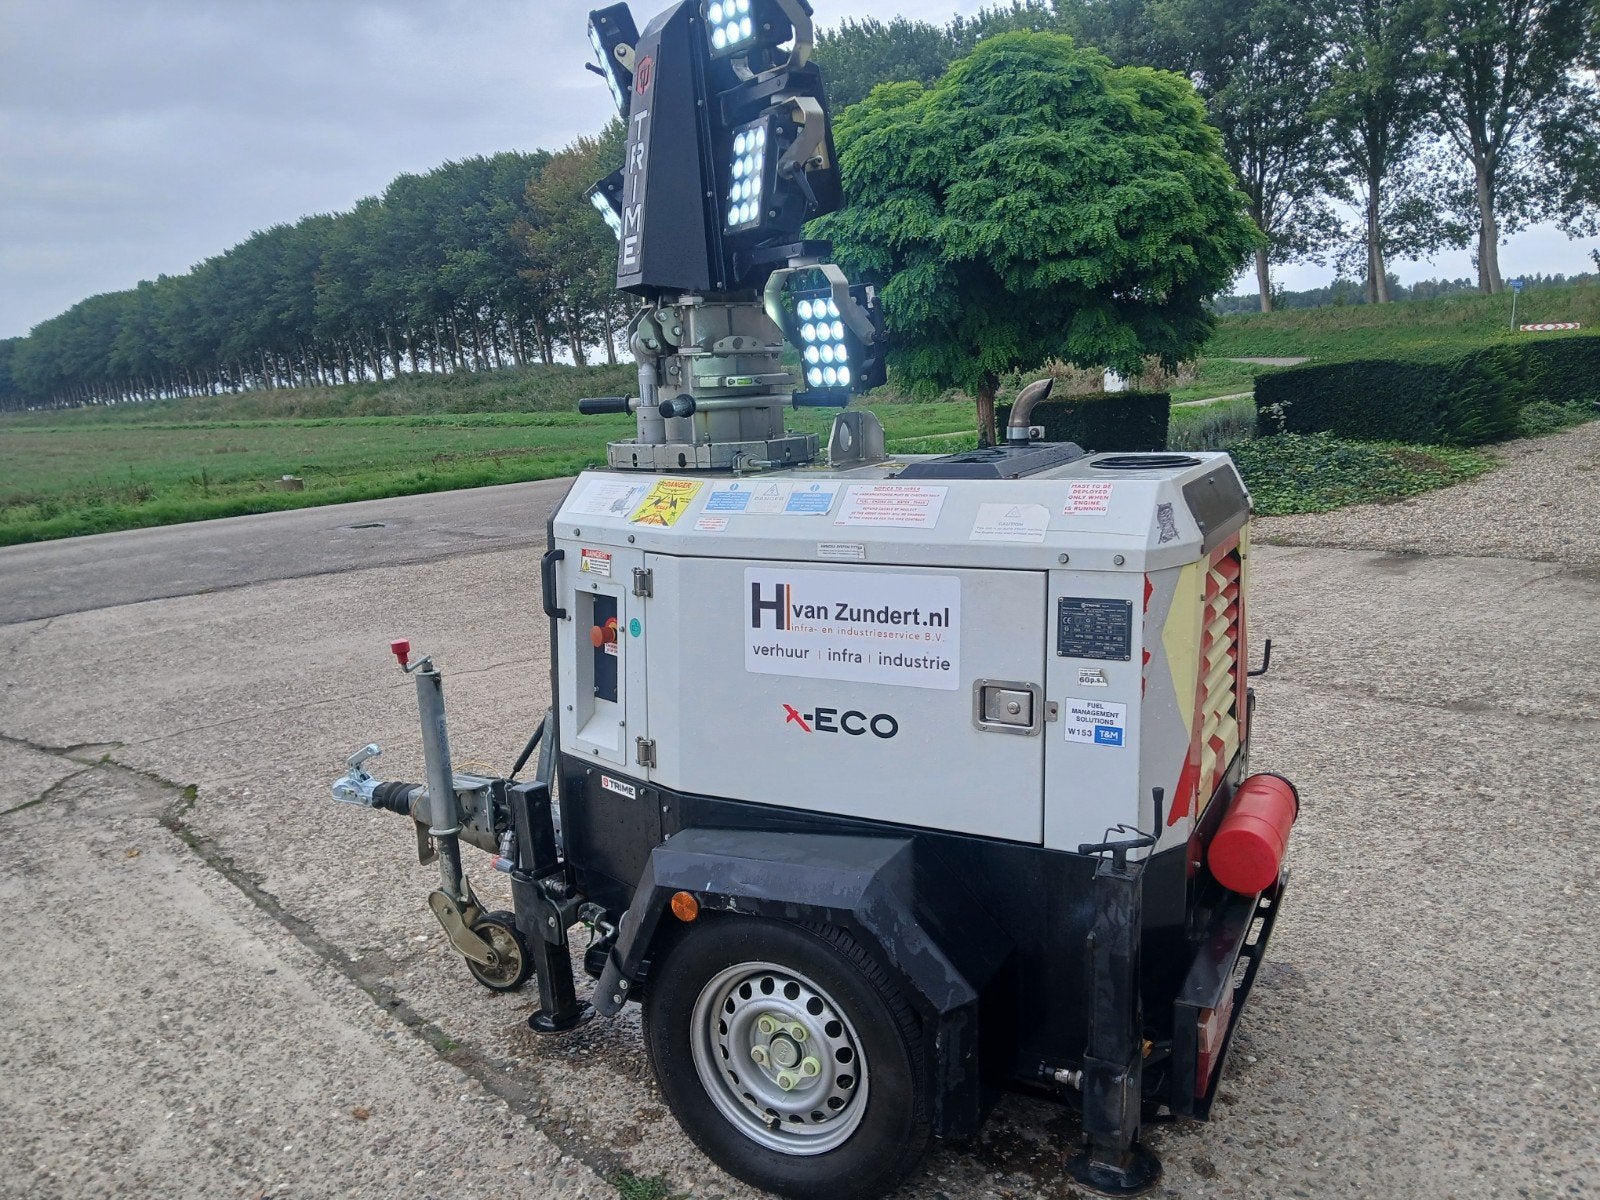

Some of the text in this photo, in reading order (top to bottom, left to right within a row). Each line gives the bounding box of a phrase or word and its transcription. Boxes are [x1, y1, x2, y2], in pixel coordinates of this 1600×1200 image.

[623, 109, 648, 266] TRIME
[792, 602, 950, 628] van Zundert.nl
[791, 624, 945, 642] infra- en industrieservice B.V.
[752, 643, 951, 671] verhuur infra industrie
[1071, 708, 1120, 719] MANAGEMENT
[1075, 716, 1114, 726] SOLUTIONS
[1068, 727, 1093, 737] W153
[1099, 730, 1119, 739] T&M
[609, 780, 634, 796] TRIME
